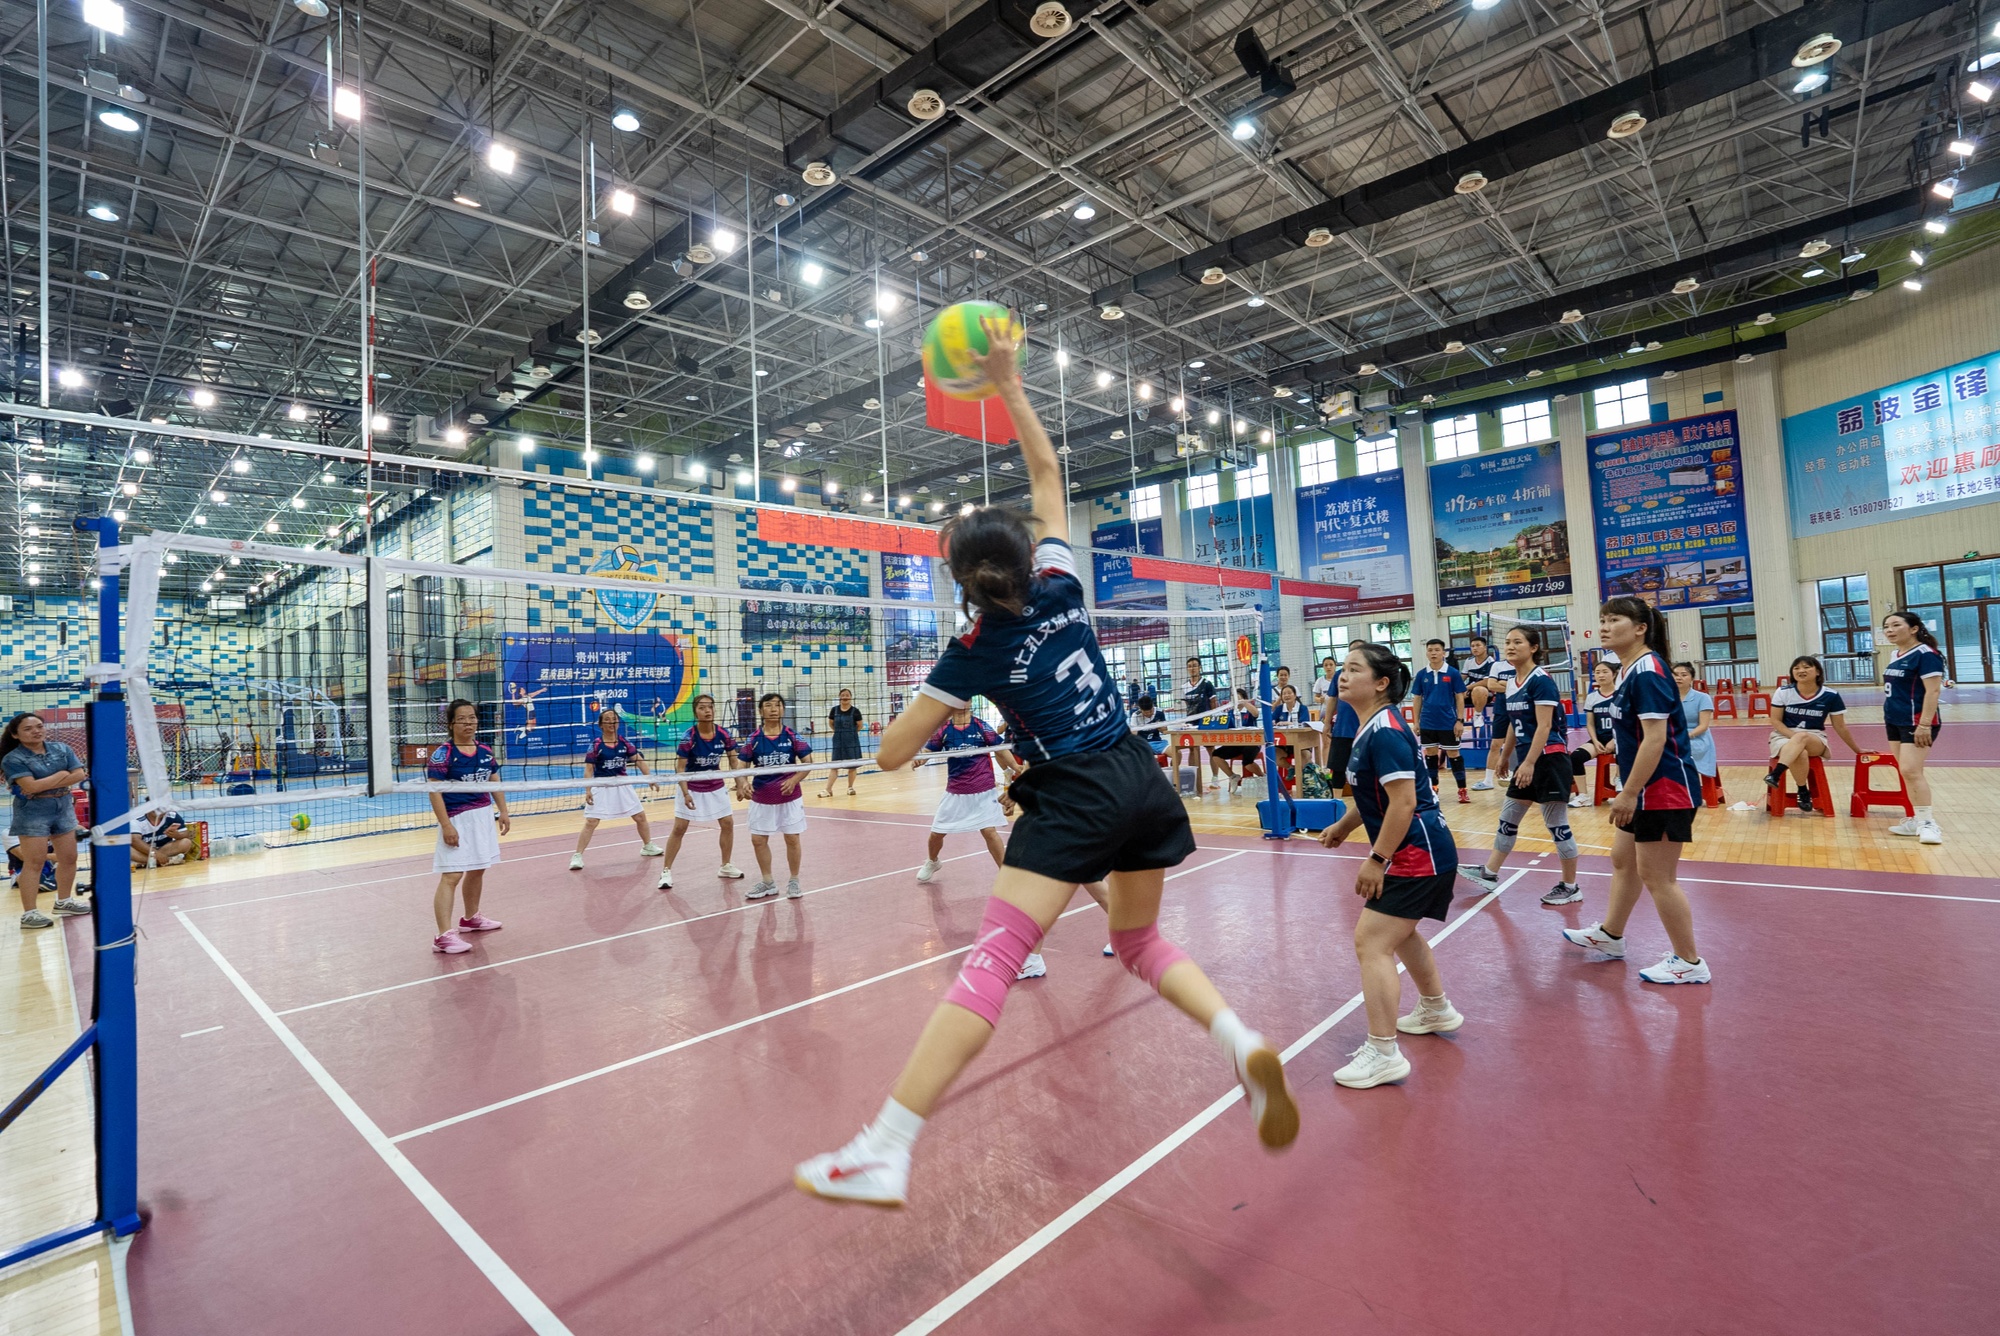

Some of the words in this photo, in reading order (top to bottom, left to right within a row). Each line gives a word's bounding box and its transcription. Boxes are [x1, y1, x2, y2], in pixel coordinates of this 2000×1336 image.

[1837, 367, 1988, 435] 荔波金锋
[1325, 496, 1377, 517] 荔波首家
[1315, 509, 1390, 534] 四代+复式楼
[1605, 520, 1737, 549] 荔波江畔壹号民宿
[1196, 534, 1264, 558] 江景现房
[1239, 590, 1256, 598] 888
[1518, 583, 1544, 595] 3617
[1545, 580, 1565, 592] 999
[575, 651, 632, 664] 贵州“村排”
[1238, 637, 1250, 662] 12
[1055, 647, 1102, 715] 3
[1885, 682, 1892, 697] 9
[1202, 716, 1211, 725] 12
[1219, 716, 1228, 725] 15
[1515, 719, 1525, 737] 2
[1601, 717, 1612, 729] 10
[1183, 738, 1190, 747] 8
[1274, 737, 1281, 746] 7
